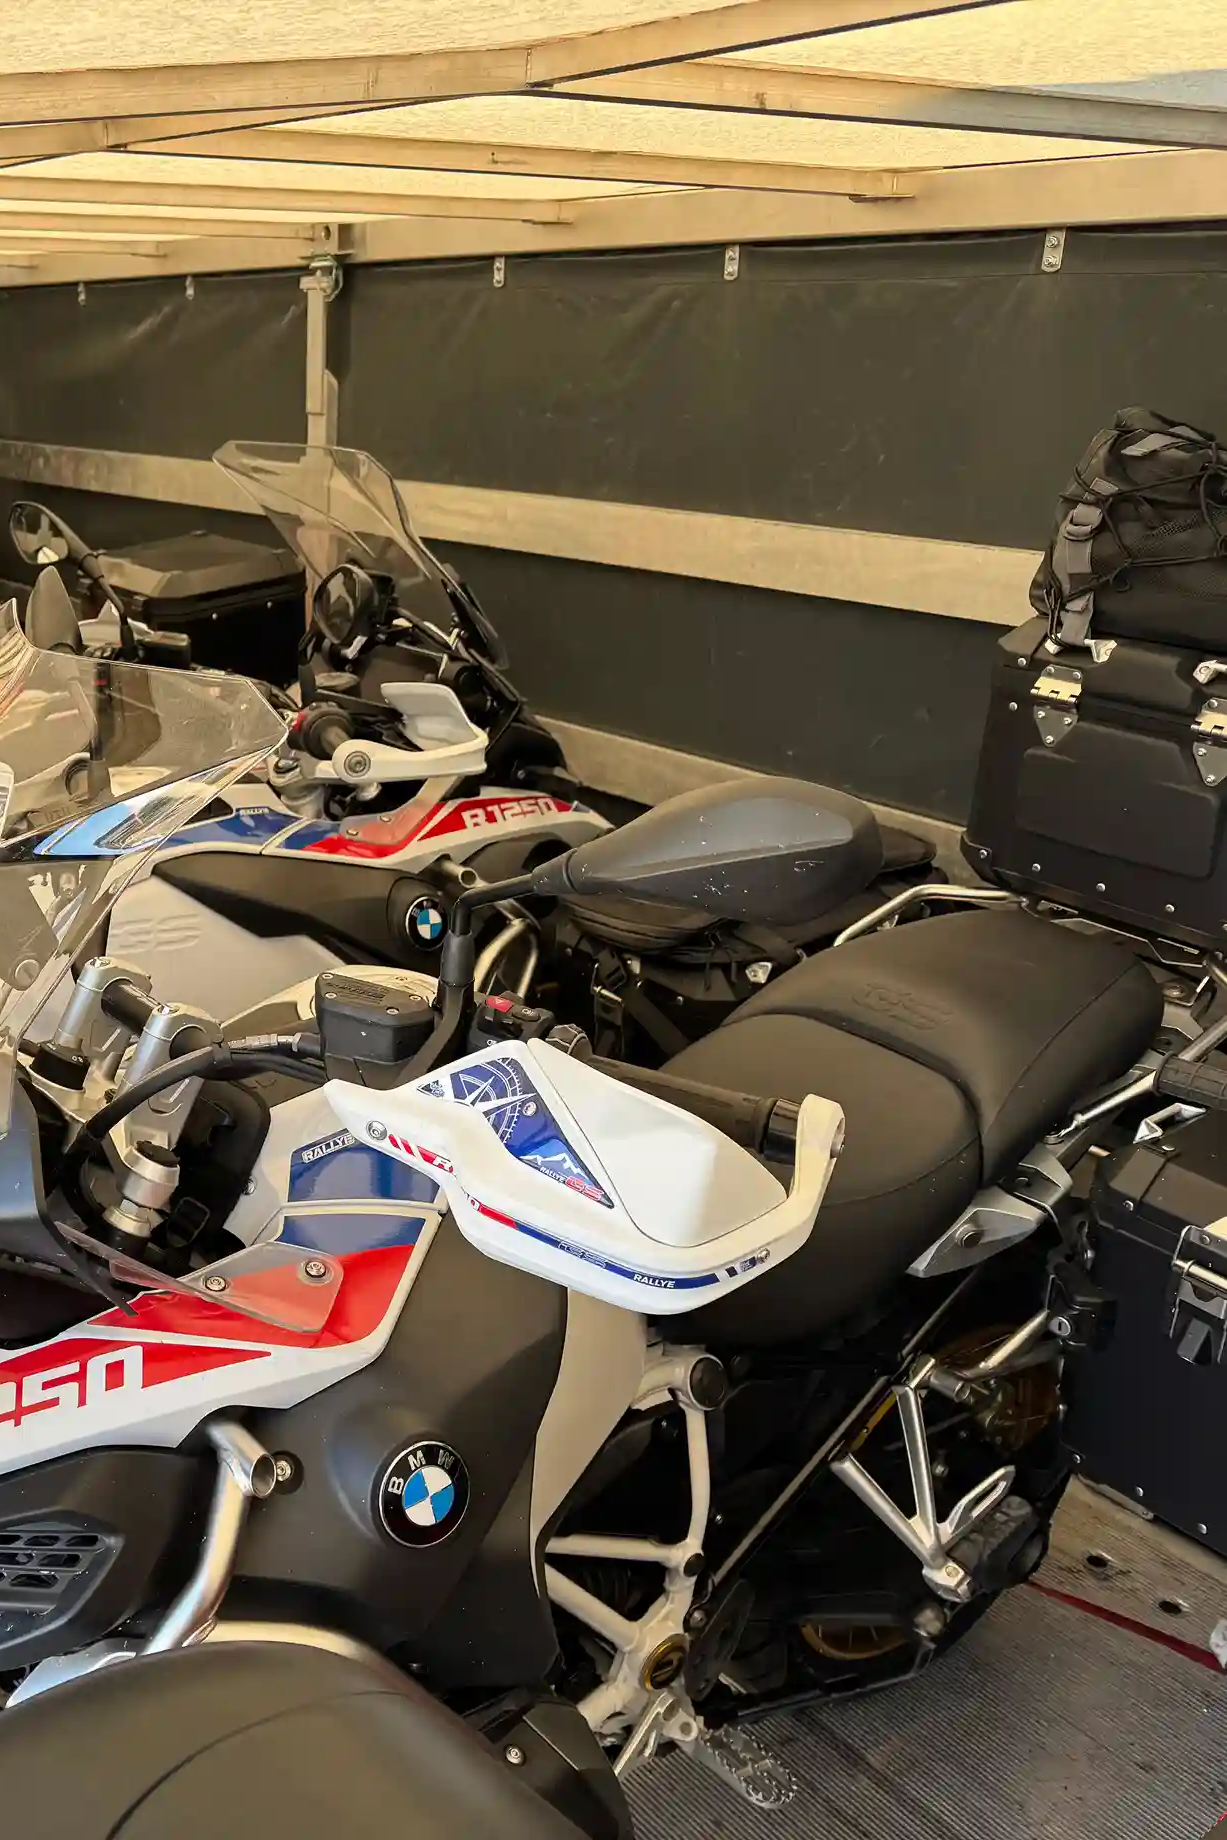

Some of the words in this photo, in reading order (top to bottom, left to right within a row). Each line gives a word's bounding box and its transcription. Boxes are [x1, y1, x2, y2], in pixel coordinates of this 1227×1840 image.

[461, 797, 557, 829] R1250
[303, 1134, 355, 1163] RALLYE
[539, 1166, 566, 1183] RALLYE
[565, 1176, 605, 1201] GS
[633, 1273, 676, 1289] RALLYE
[387, 1449, 455, 1495] BMW
